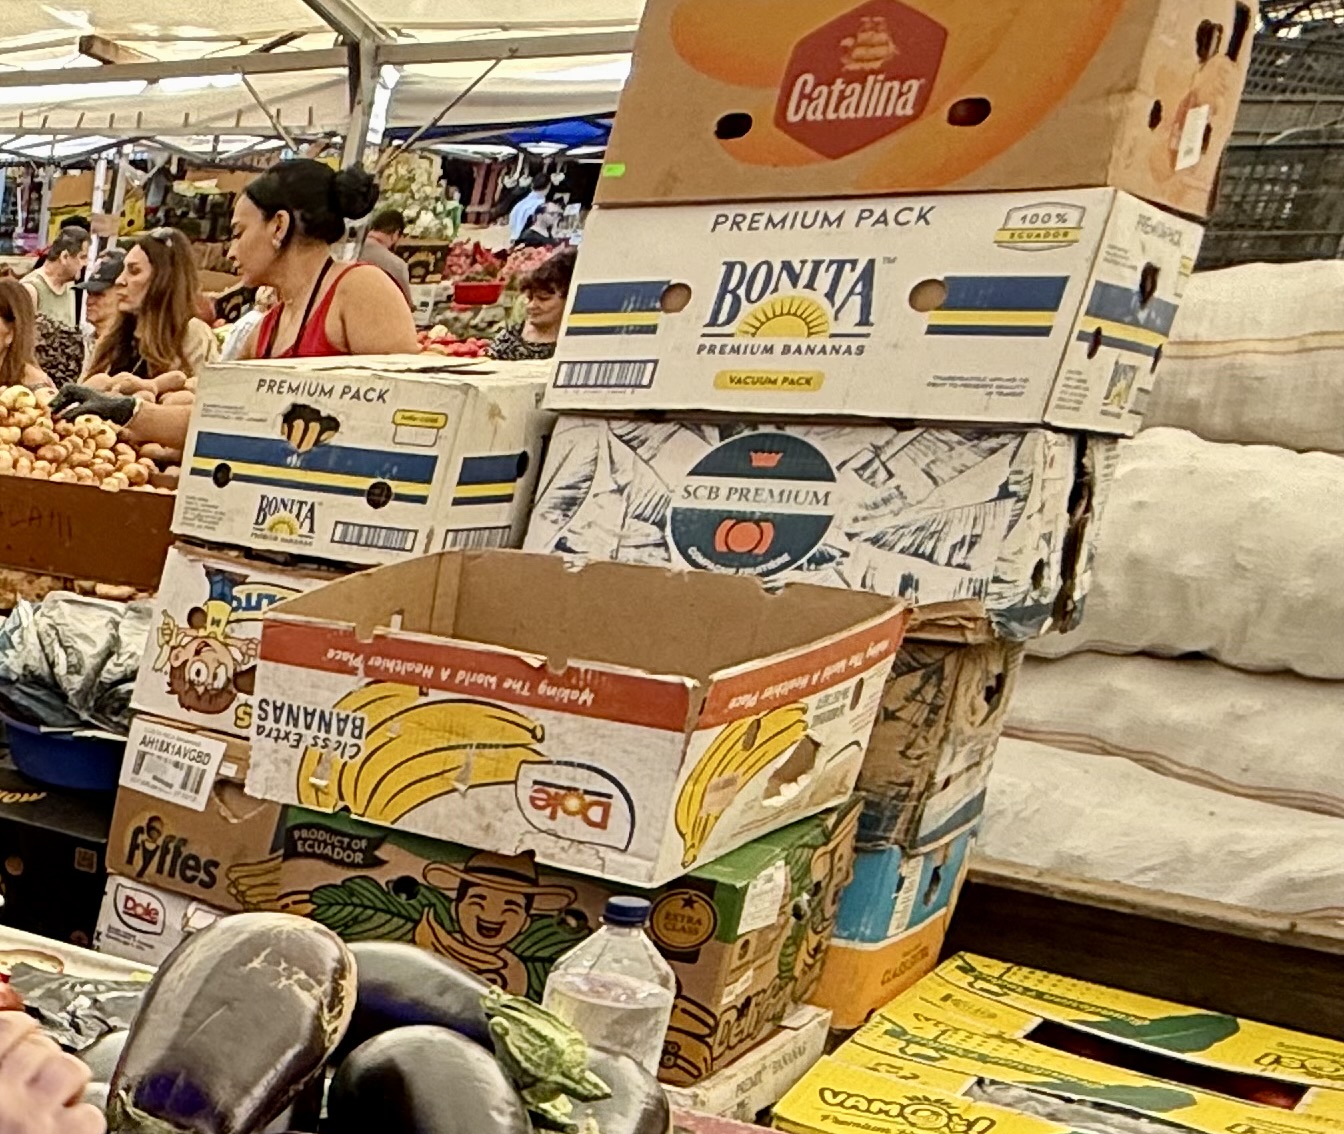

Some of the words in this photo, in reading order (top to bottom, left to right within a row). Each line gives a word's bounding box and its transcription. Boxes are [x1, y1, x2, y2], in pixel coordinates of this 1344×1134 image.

[786, 72, 920, 123] Catalina
[711, 209, 846, 233] PREMIUM
[855, 205, 937, 228] PACK
[1019, 212, 1069, 225] 100%
[703, 257, 876, 328] BONITA
[697, 343, 774, 356] PREMIUM
[781, 343, 865, 356] BANANAS
[256, 378, 336, 399] PREMIUM
[339, 385, 392, 404] PACK
[729, 375, 778, 386] VACUUM
[781, 376, 813, 387] PACK
[681, 484, 720, 501] SCB
[725, 486, 832, 507] PREMIUM
[253, 494, 315, 534] BONITA
[439, 667, 451, 680] A
[456, 670, 497, 691] World
[502, 678, 531, 696] The
[257, 699, 365, 741] BANANAS
[255, 723, 302, 749] Extra
[529, 787, 612, 831] Dole
[293, 826, 349, 850] PRODUCT
[351, 838, 368, 850] OF
[126, 815, 221, 890] fyffes
[296, 840, 364, 865] ECUADOR
[122, 894, 160, 926] Dole
[664, 911, 703, 927] EXTRA
[664, 922, 700, 936] CLASS
